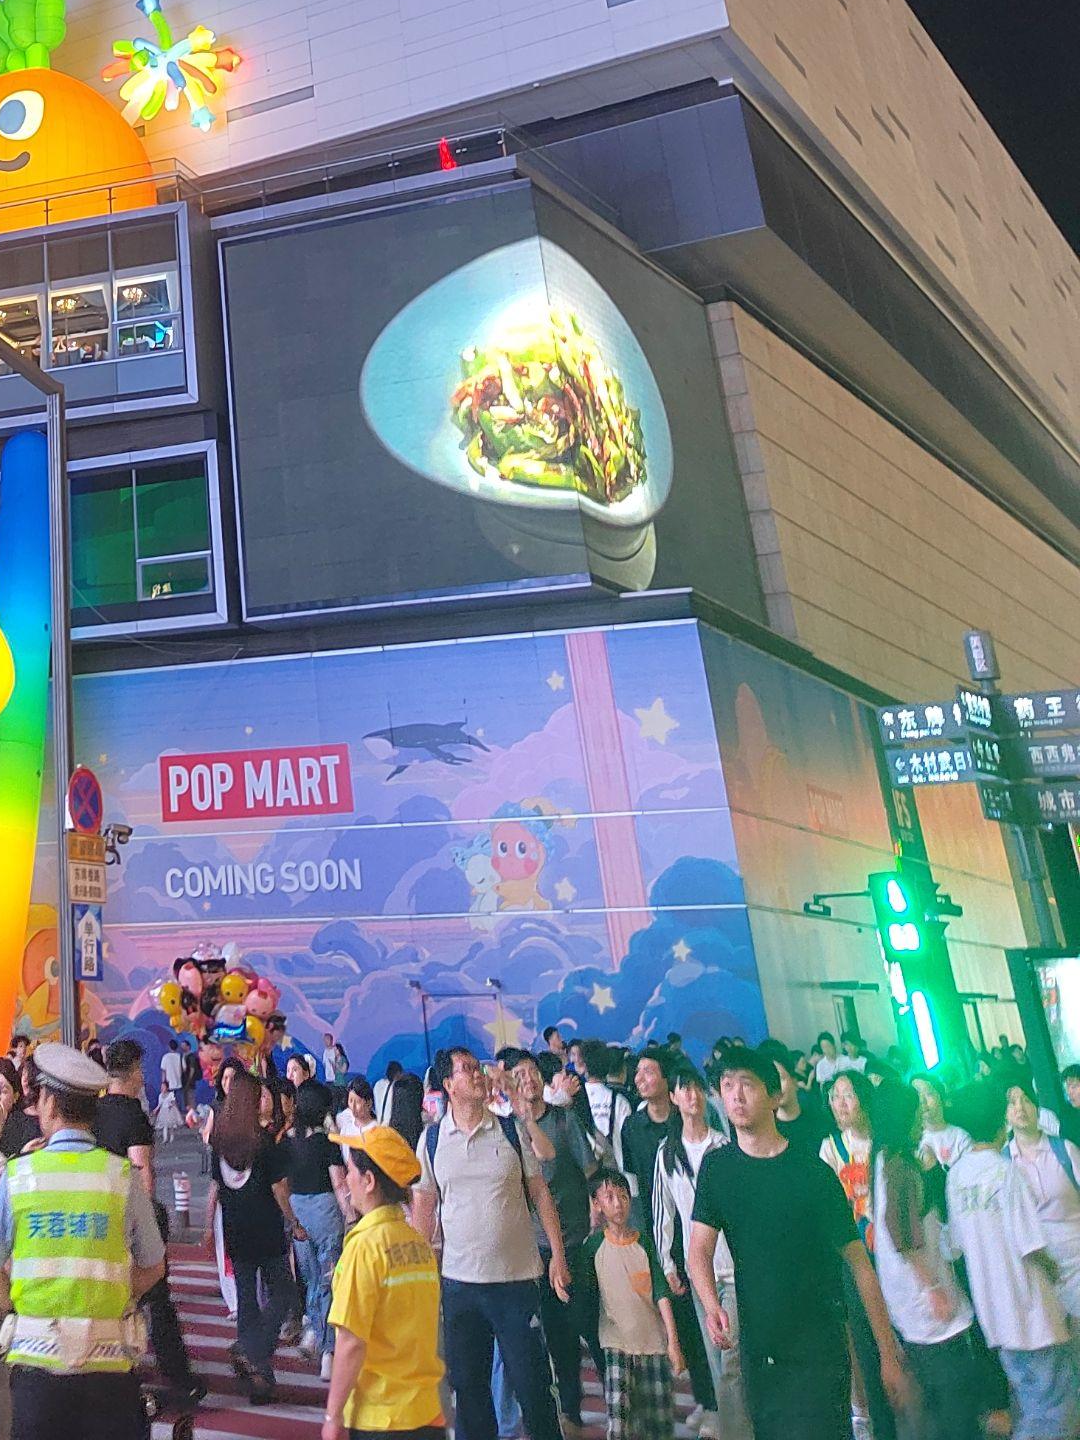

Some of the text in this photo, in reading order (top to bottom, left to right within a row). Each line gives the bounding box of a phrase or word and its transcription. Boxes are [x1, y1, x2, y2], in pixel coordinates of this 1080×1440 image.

[1014, 695, 1080, 720] 药王
[1029, 743, 1080, 765] 西西弗
[168, 755, 340, 813] POP MART
[1038, 789, 1080, 811] 城市
[165, 859, 362, 898] COMING SOON
[83, 921, 96, 972] 单行路
